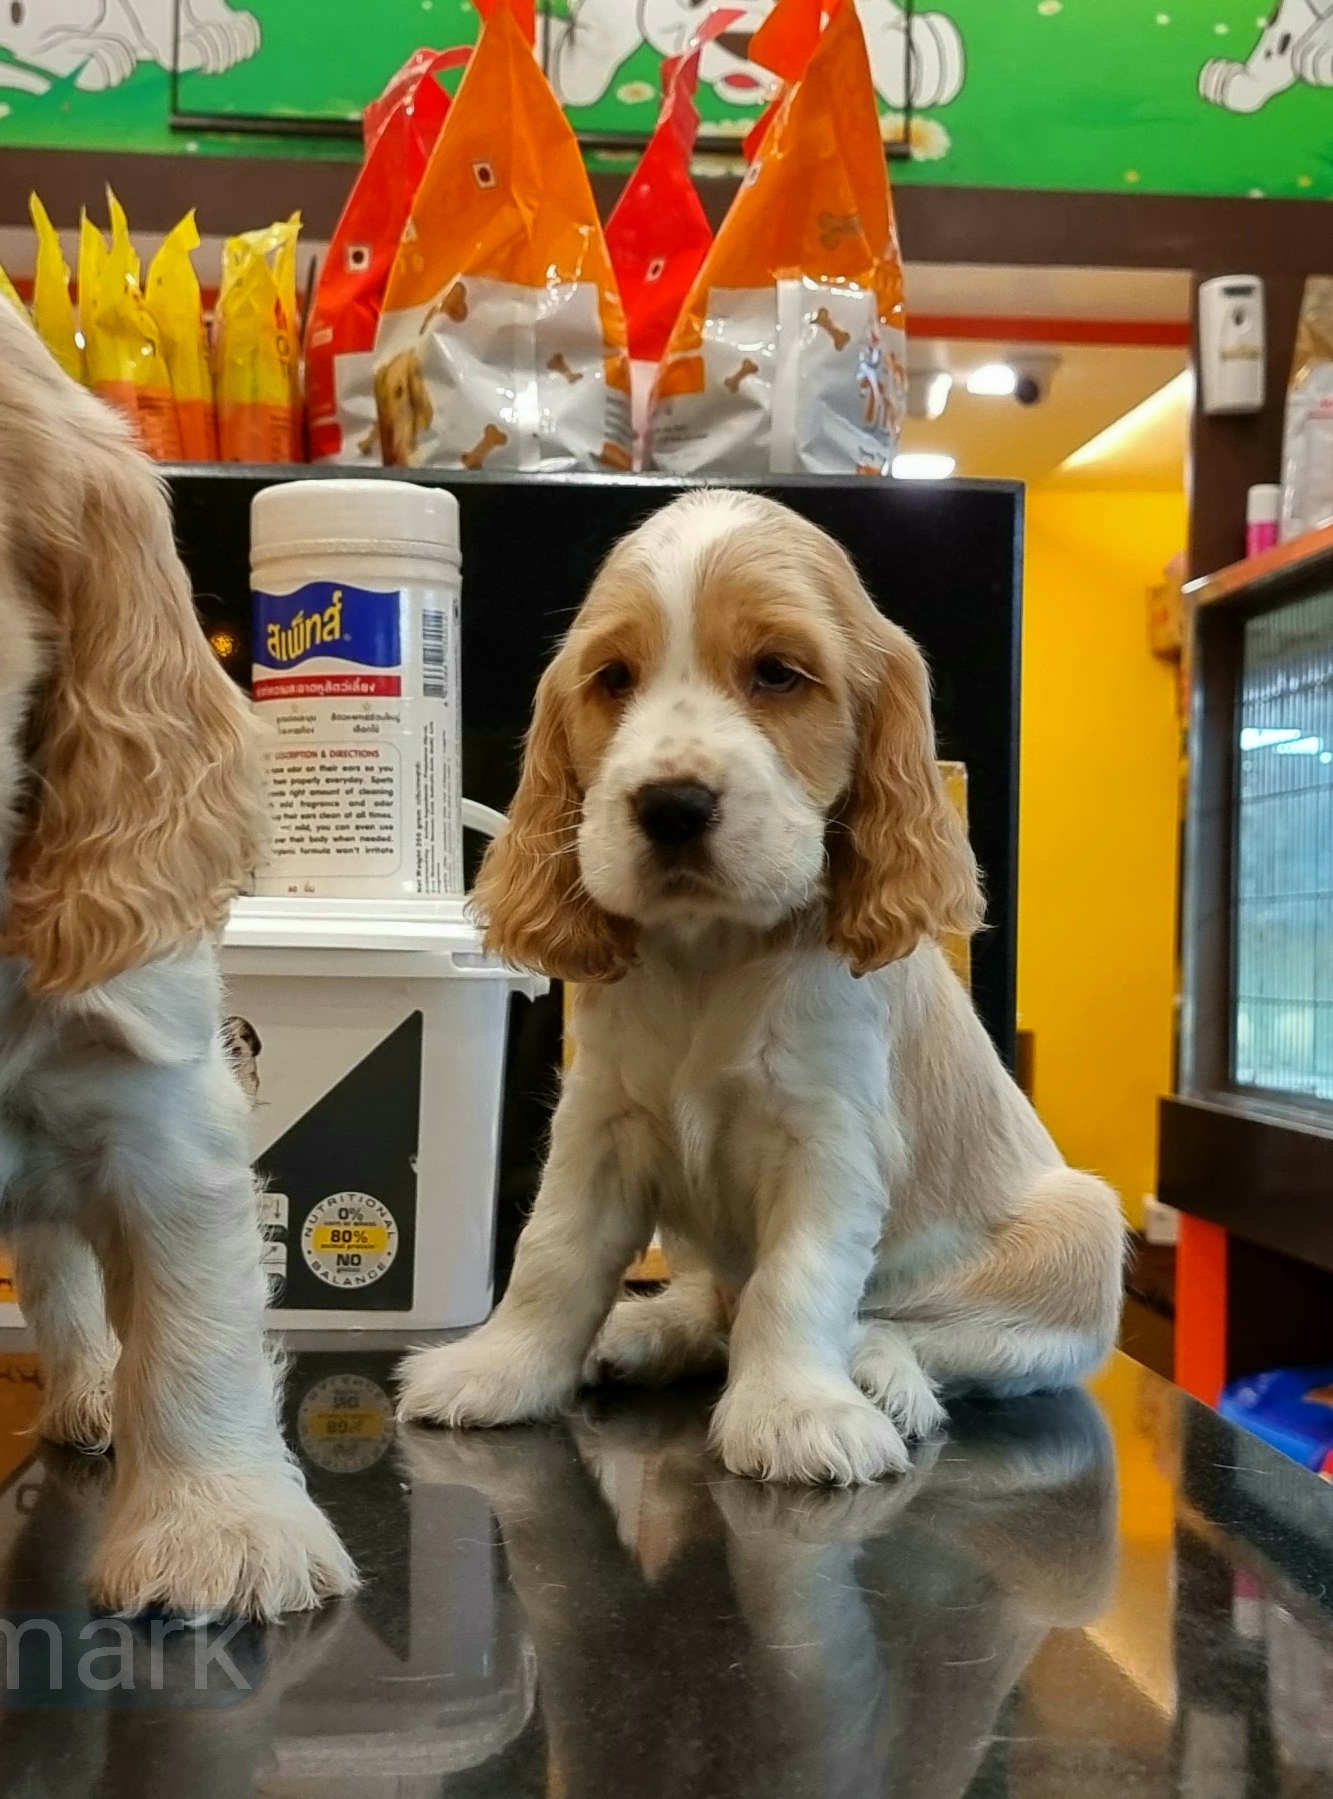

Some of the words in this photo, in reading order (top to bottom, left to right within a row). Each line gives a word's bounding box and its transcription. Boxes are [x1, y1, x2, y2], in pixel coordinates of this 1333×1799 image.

[329, 749, 380, 759] DIRECTIONS
[378, 765, 394, 774] you
[358, 787, 394, 798] cleaning
[316, 824, 331, 833] you
[303, 1193, 396, 1239] NUTRITIONAL
[338, 1207, 364, 1221] 0%
[330, 1229, 368, 1243] 80%
[336, 1253, 362, 1267] NO
[311, 1260, 386, 1286] BALANCE
